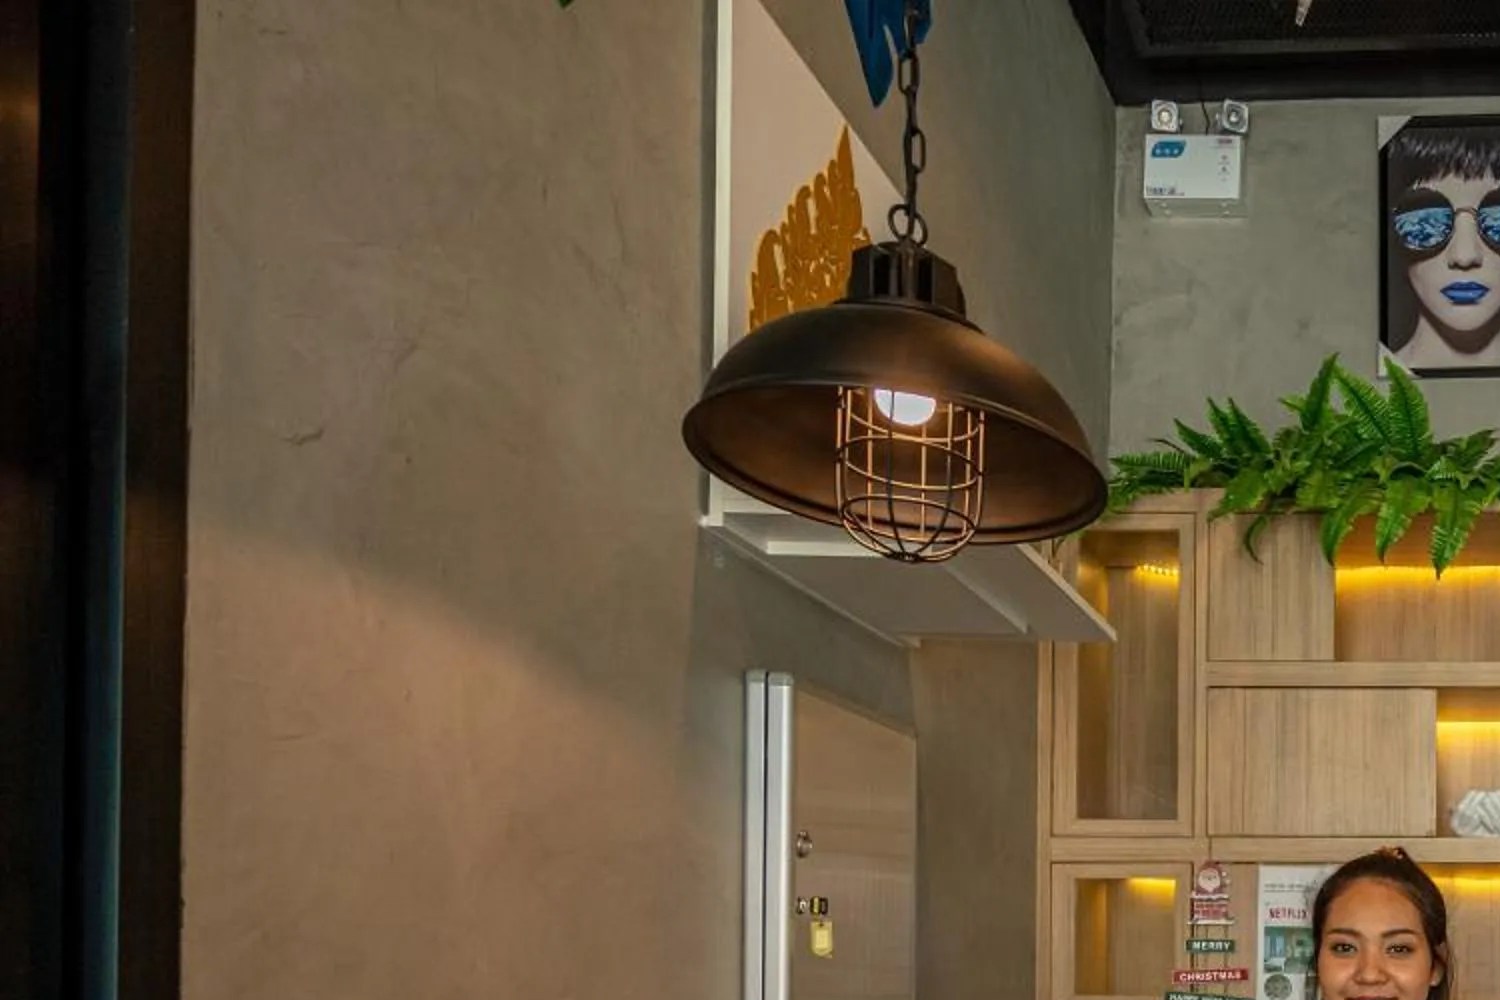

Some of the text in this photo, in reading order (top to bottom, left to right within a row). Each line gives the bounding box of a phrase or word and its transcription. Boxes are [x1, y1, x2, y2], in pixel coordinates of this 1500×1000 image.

[1269, 907, 1307, 920] NETFLIX
[1192, 941, 1231, 951] MERRY
[1179, 970, 1241, 983] CHRISTMAS
